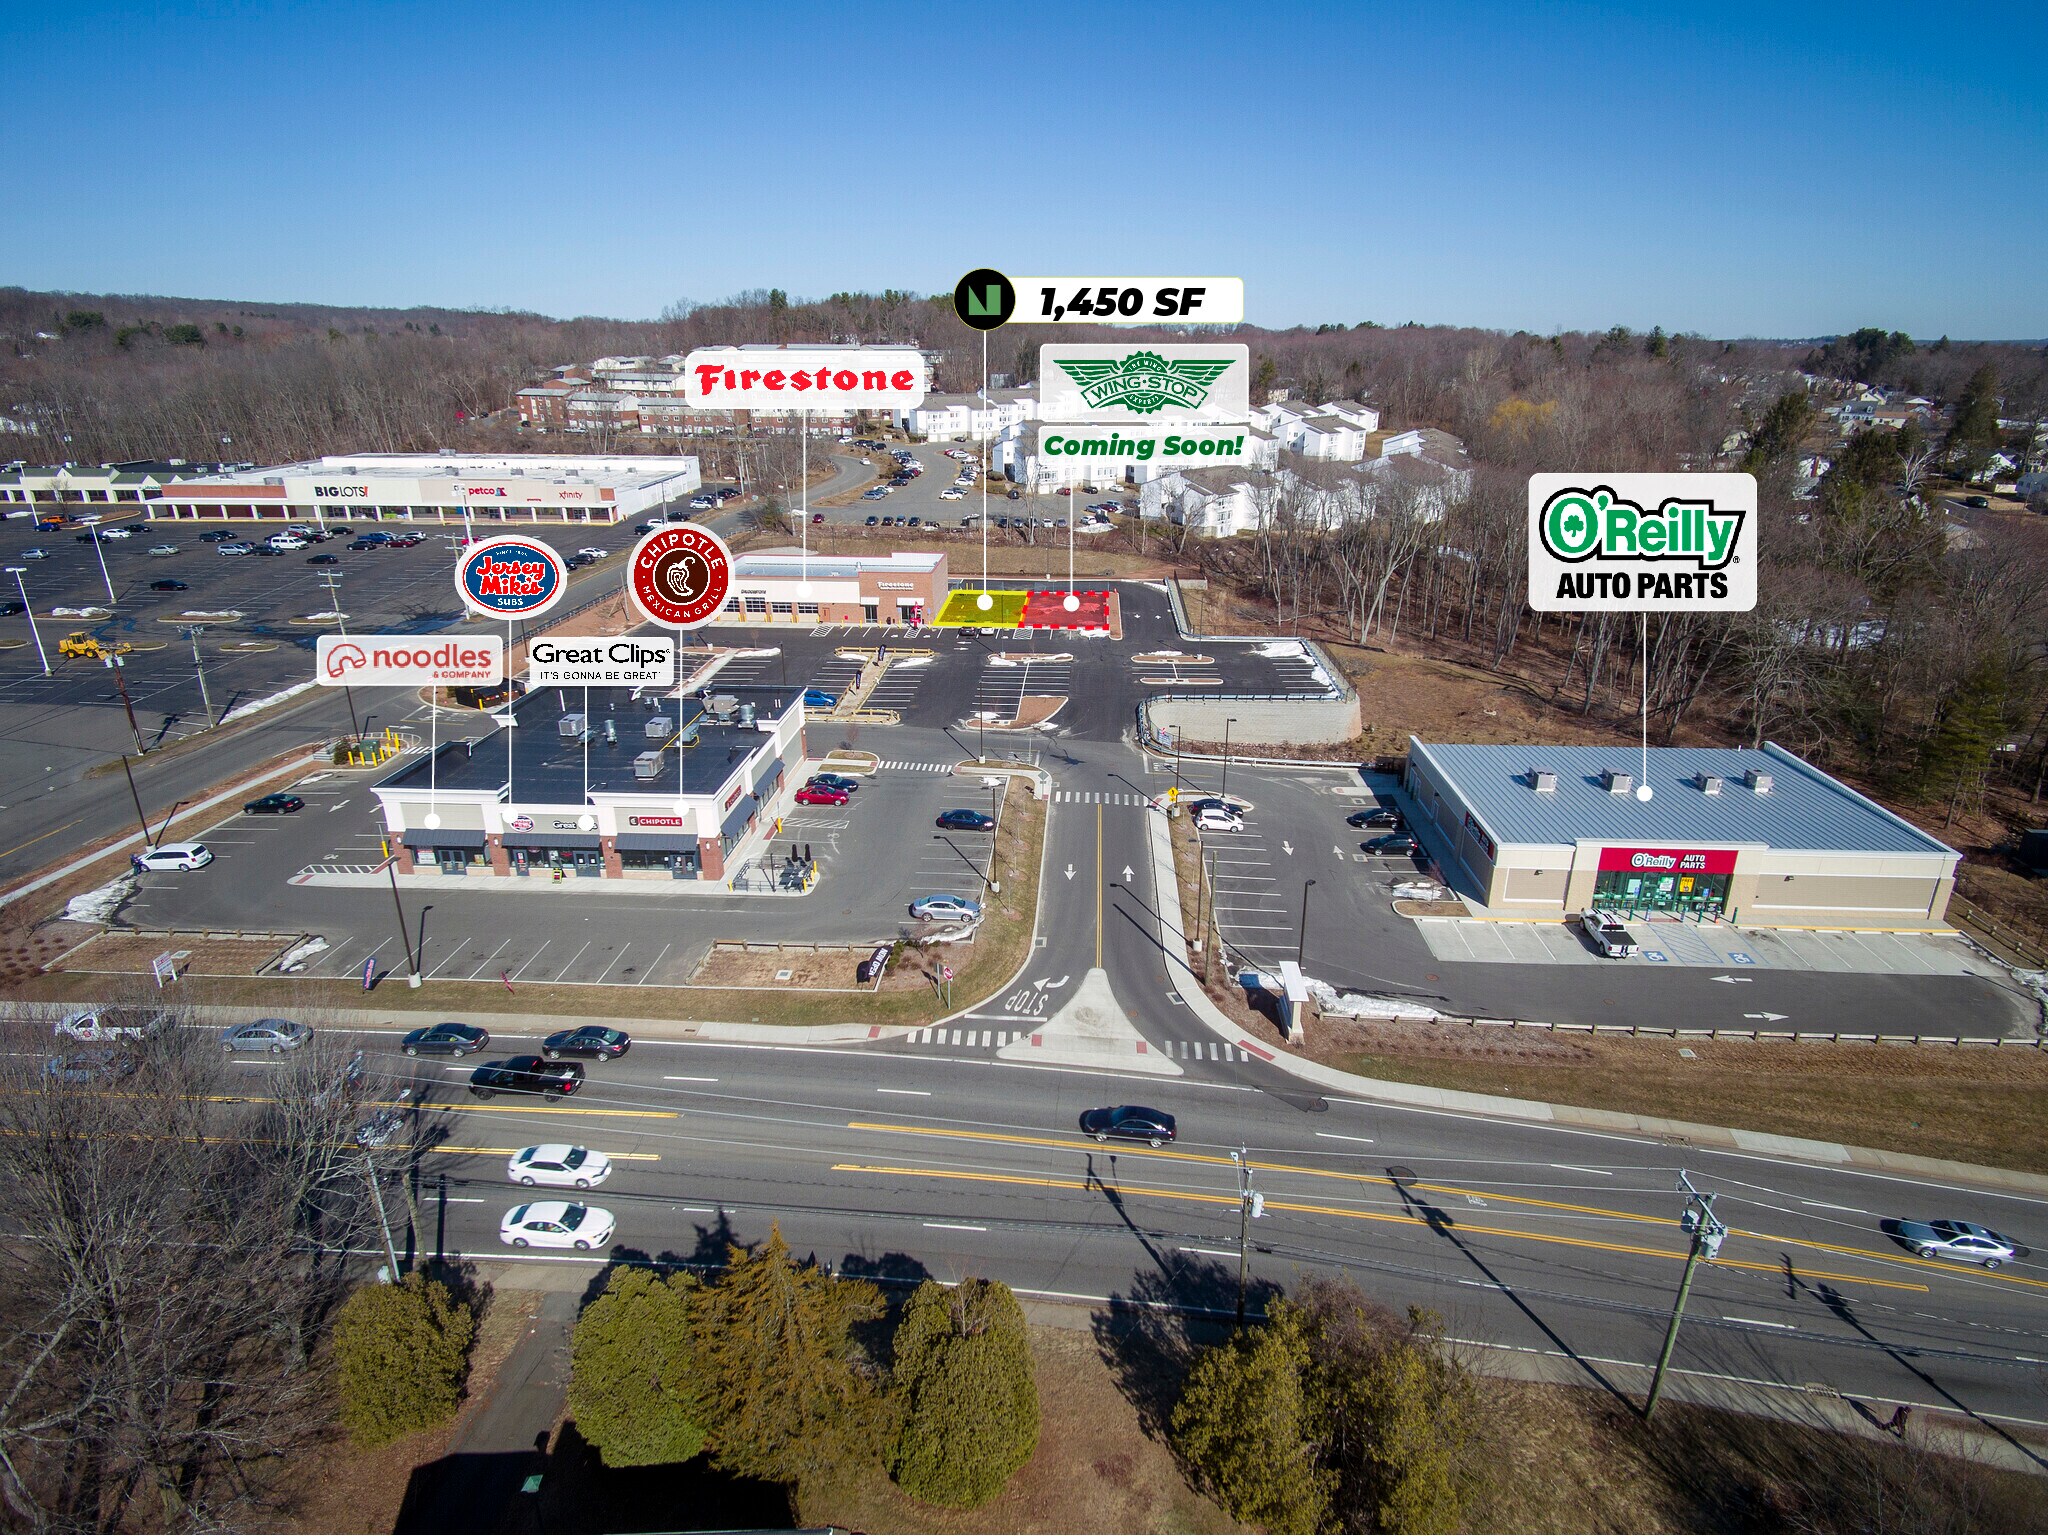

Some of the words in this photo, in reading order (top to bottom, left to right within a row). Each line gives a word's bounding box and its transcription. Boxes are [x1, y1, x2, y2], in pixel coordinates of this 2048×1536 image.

[468, 487, 495, 496] petco
[558, 490, 583, 499] xfinity
[552, 820, 577, 830] Great
[1632, 853, 1675, 869] O'Reilly
[1684, 854, 1706, 862] AUTO
[1680, 861, 1706, 869] PARTS
[1004, 989, 1049, 1016] STOP
